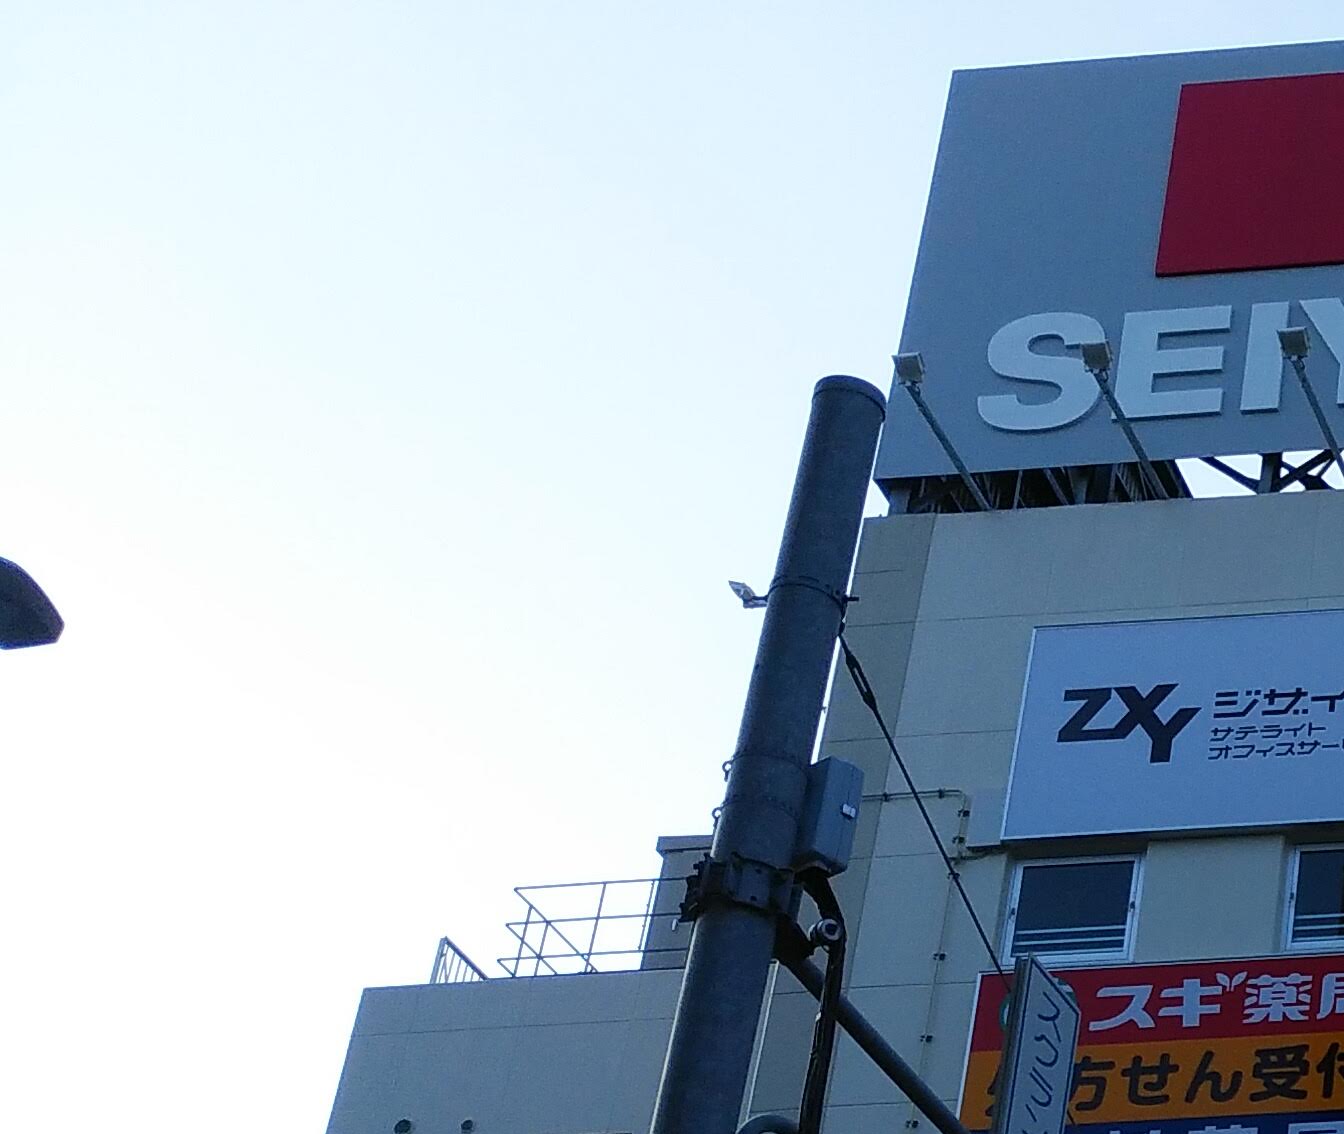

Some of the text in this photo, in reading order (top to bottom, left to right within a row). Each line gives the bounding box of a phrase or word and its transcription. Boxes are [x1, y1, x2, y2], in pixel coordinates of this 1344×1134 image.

[1057, 683, 1201, 764] ZXY
[1209, 722, 1327, 742] サテライト
